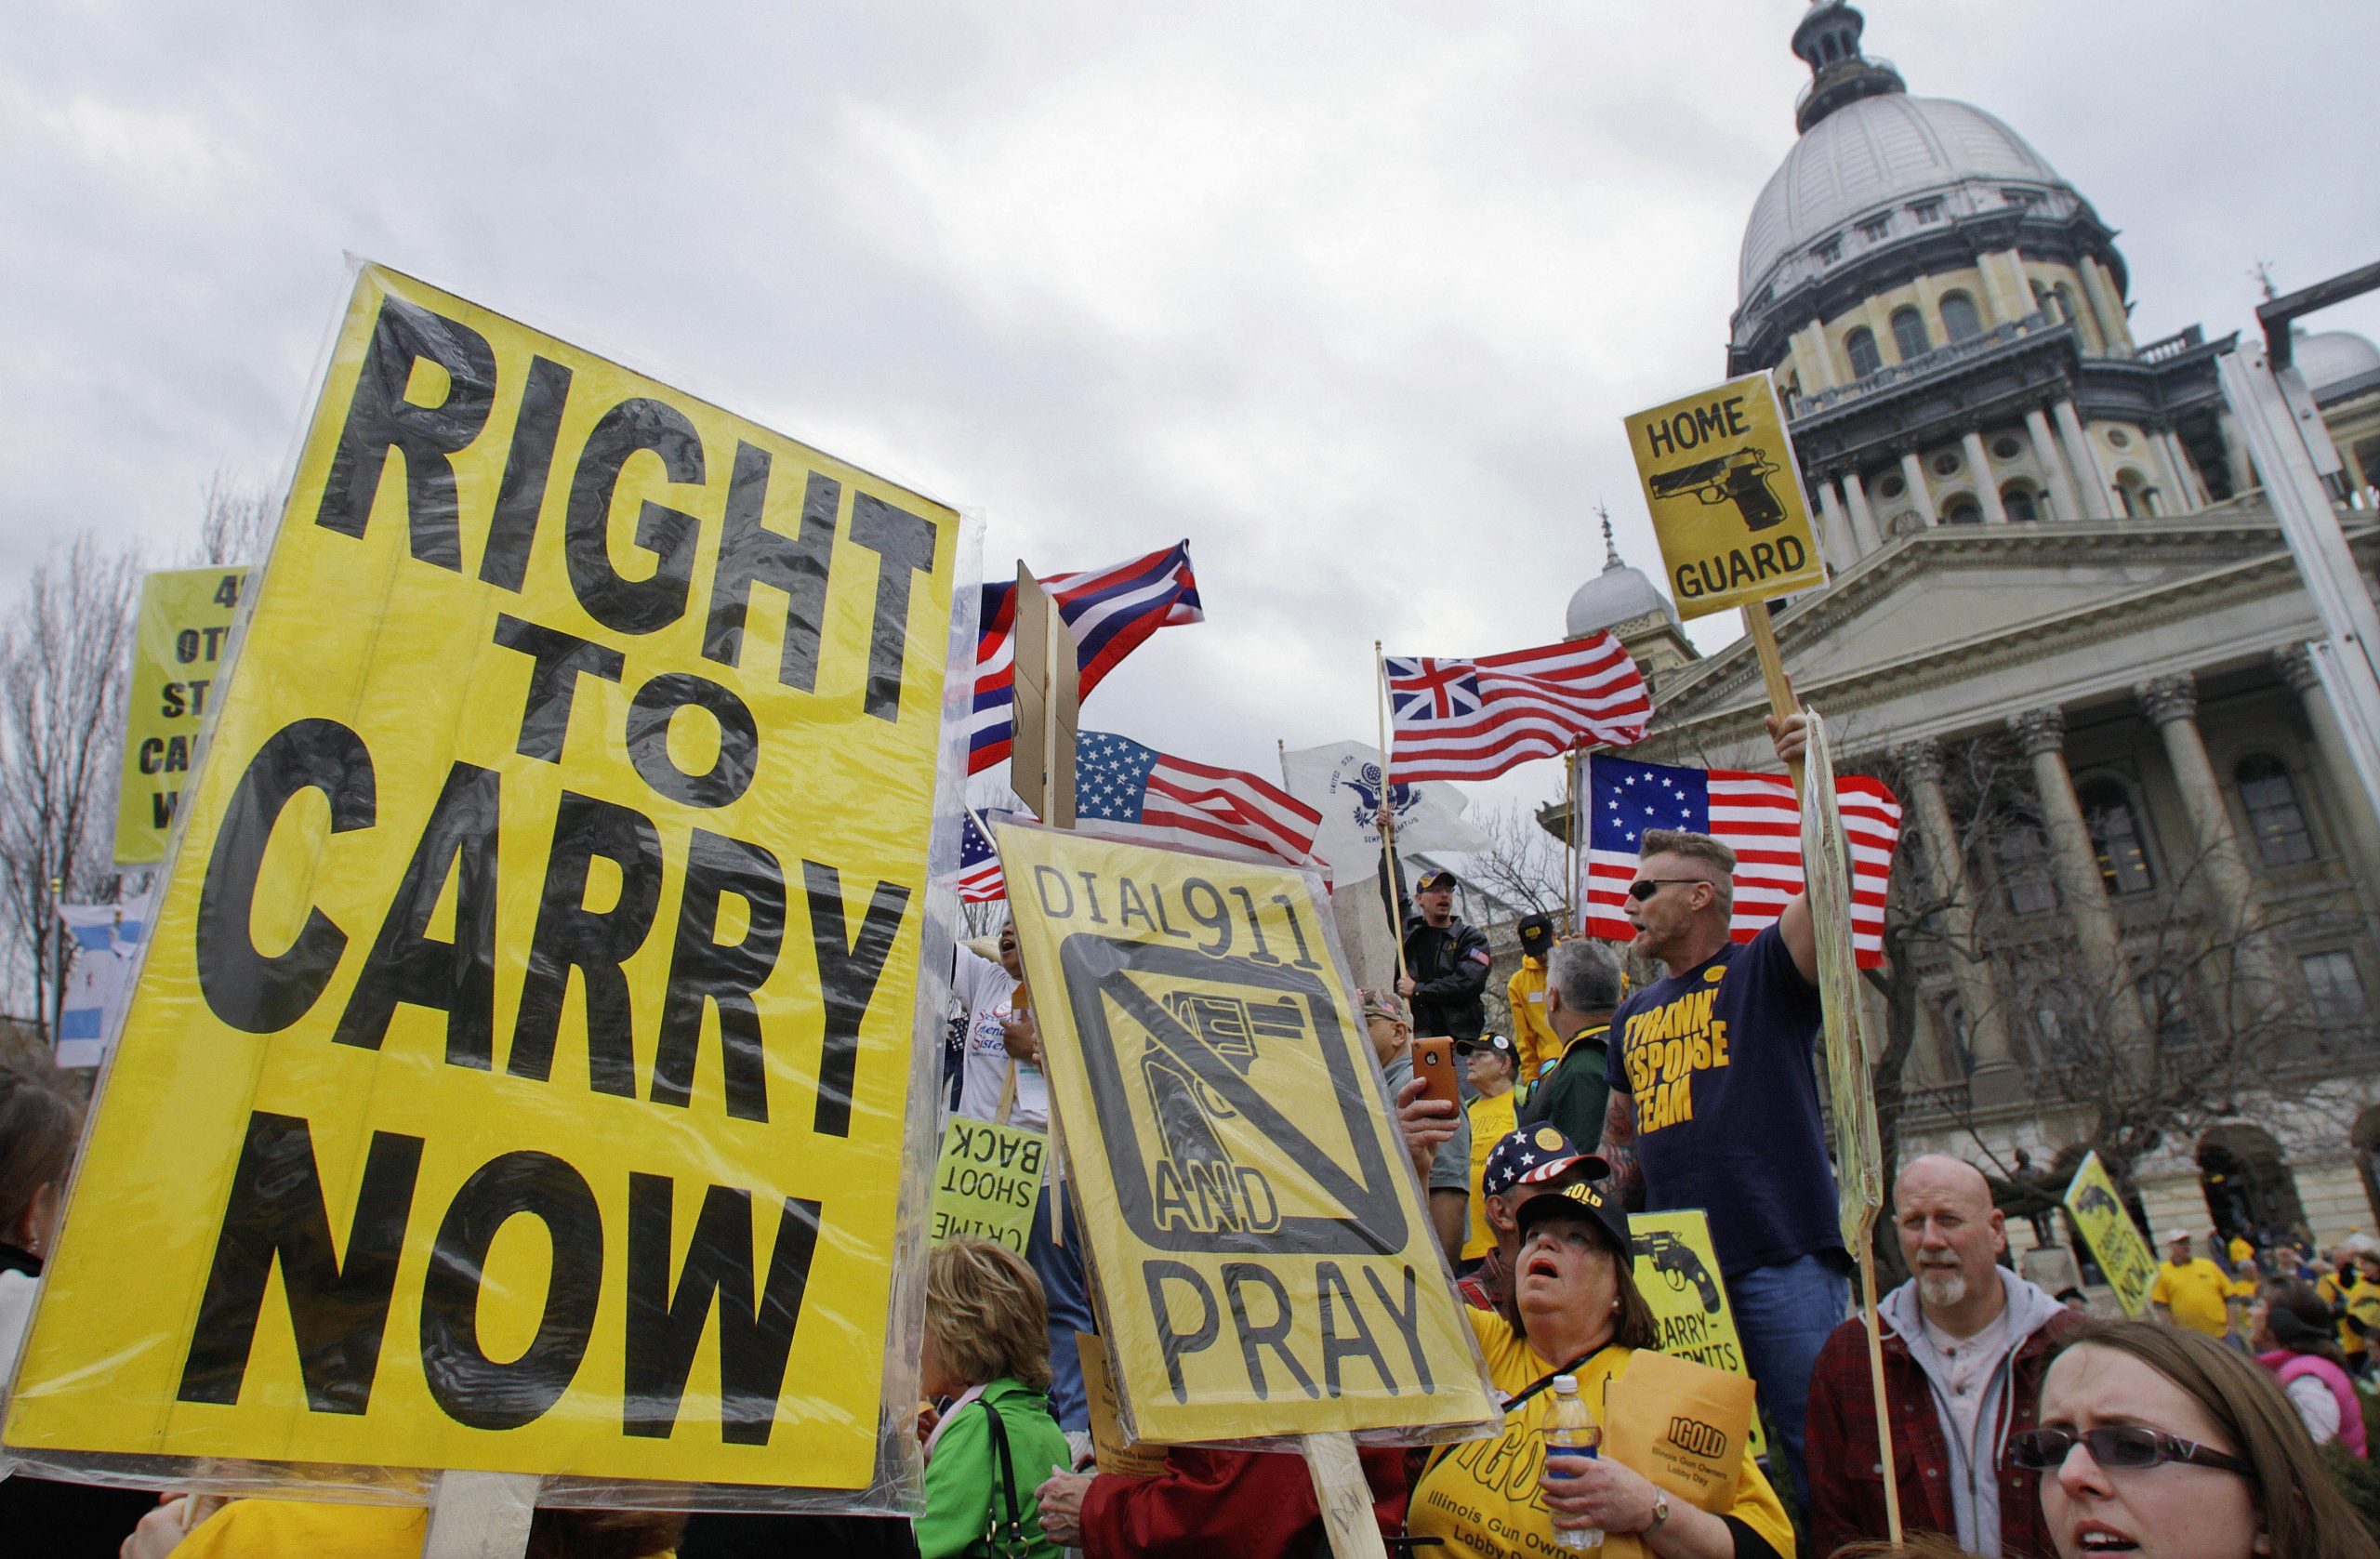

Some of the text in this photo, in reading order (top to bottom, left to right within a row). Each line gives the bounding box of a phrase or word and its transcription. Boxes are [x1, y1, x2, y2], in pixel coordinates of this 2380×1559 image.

[1646, 396, 1751, 457] HOME
[315, 295, 937, 722] RIGHT
[1676, 535, 1805, 598] GUARD
[492, 612, 758, 808] TO
[1364, 835, 1381, 843] SEMP
[197, 718, 911, 1139] CARRY
[1034, 864, 1322, 971] DIAL 911
[1634, 1073, 1693, 1136] TEAM
[951, 1124, 1042, 1174] BACK
[941, 1167, 1032, 1208] SHOOT
[1154, 1157, 1282, 1236] AND
[176, 1110, 822, 1446] NOW
[1142, 1259, 1435, 1406] PRAY
[1652, 1446, 1728, 1481] Illinois Gun Owners
[1668, 1416, 1726, 1460] IGOLD
[1667, 1464, 1709, 1487] Lobby Day
[1427, 1490, 1580, 1559] Illinois Gun Owne
[1454, 1525, 1506, 1559] Lobby
